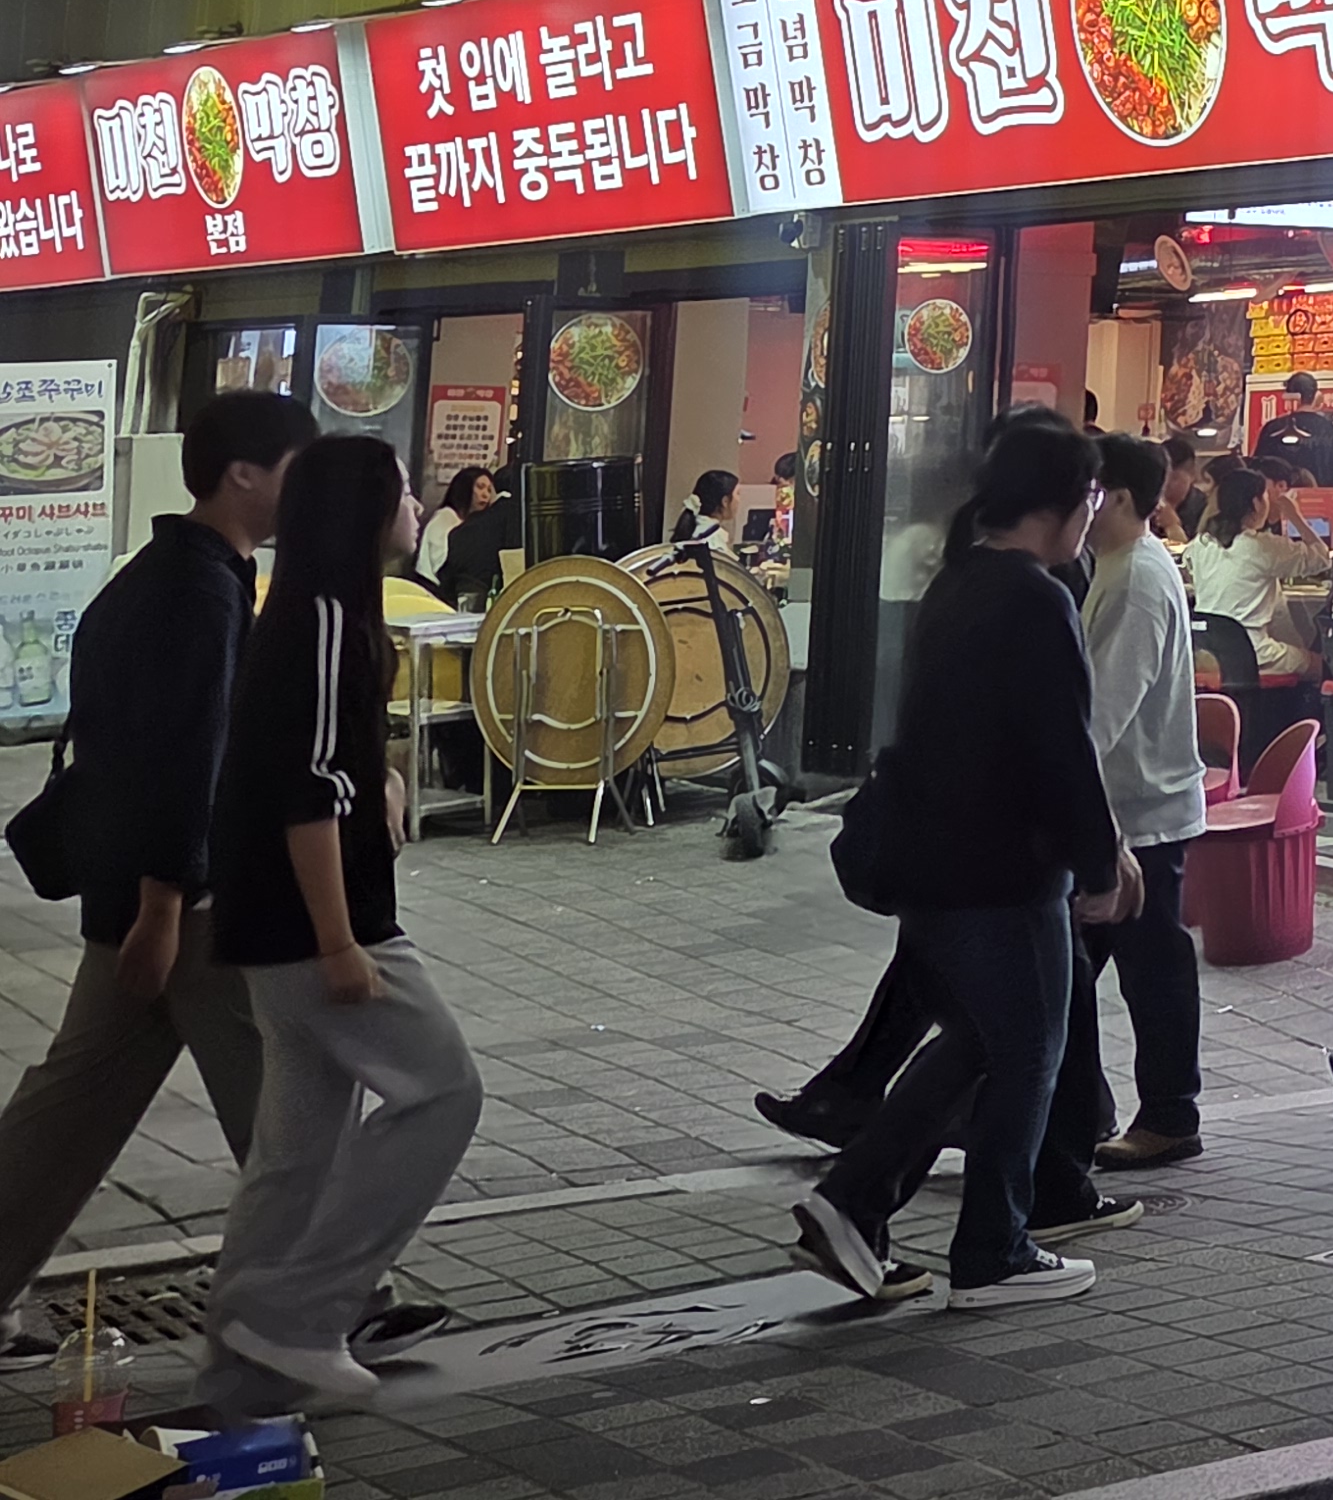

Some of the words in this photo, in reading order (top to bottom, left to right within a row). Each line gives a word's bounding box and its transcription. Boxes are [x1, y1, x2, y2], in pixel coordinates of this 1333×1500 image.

[417, 45, 455, 118] 첫
[458, 28, 530, 109] 입에
[537, 12, 655, 100] 놀라고
[93, 92, 187, 201] 미친
[237, 64, 341, 184] 막창
[403, 132, 506, 215] 끝까지
[511, 103, 699, 202] 중독됩니다
[204, 210, 247, 256] 본점
